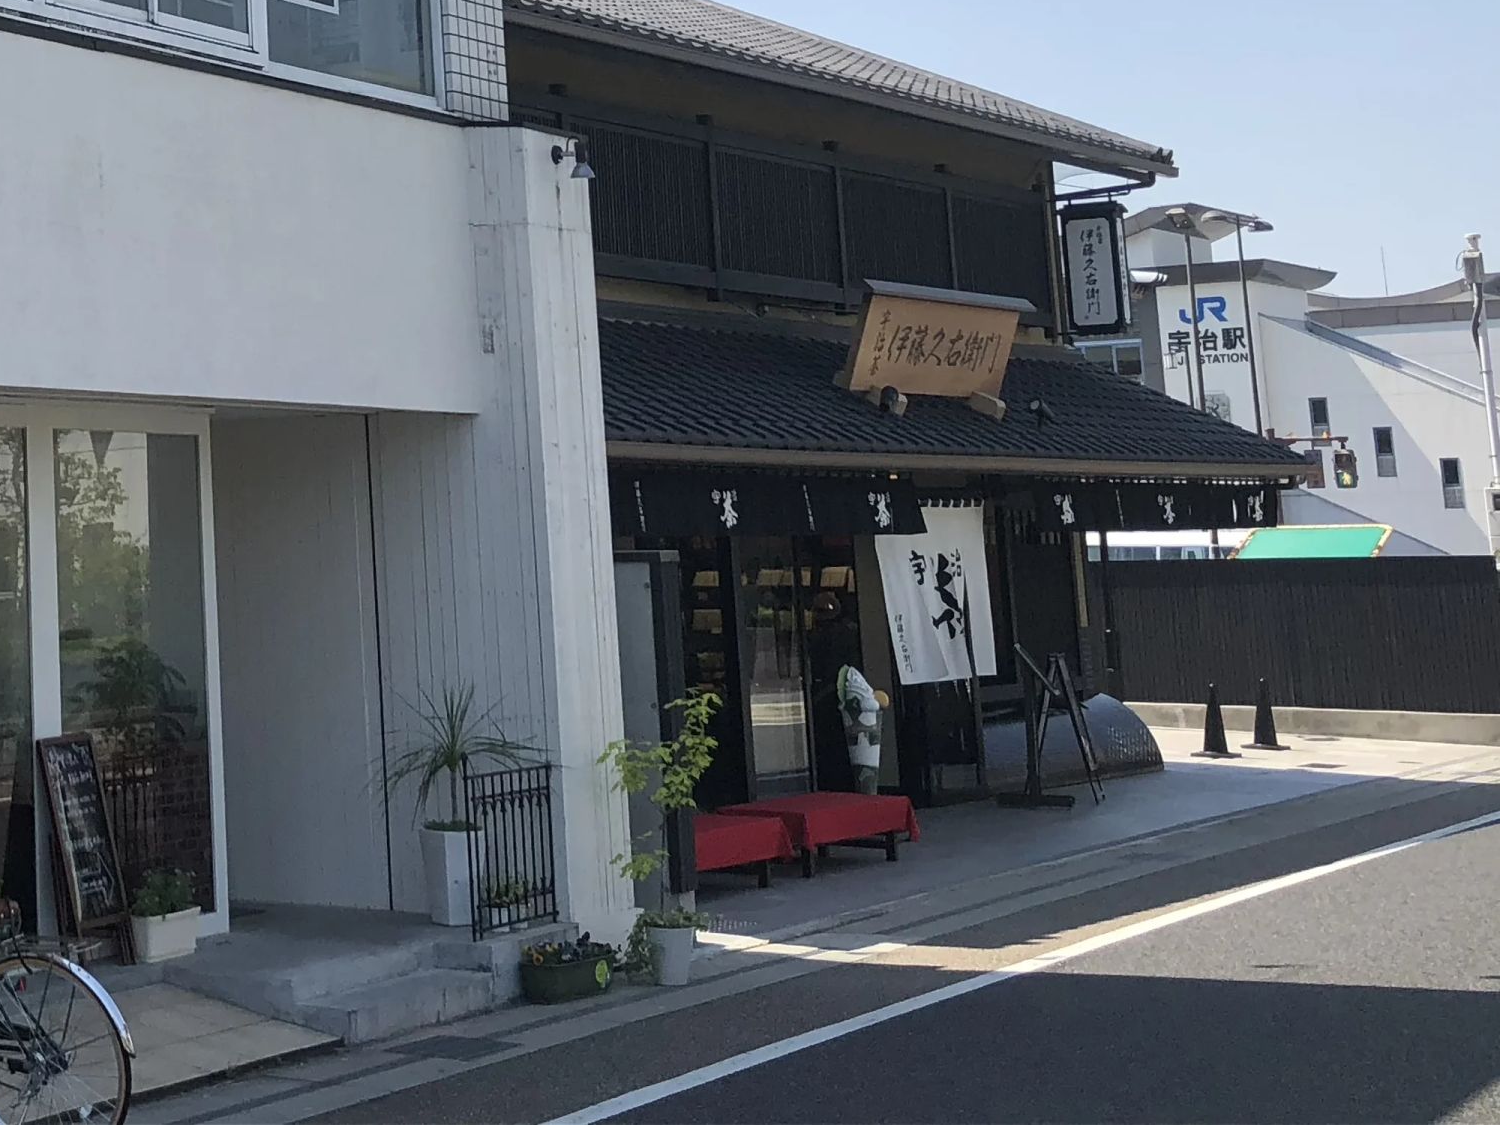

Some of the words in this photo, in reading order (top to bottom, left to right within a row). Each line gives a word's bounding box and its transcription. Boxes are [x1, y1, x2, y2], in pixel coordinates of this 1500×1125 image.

[1080, 228, 1101, 316] 伊藤久右衛門
[1179, 296, 1228, 324] JR
[888, 325, 1001, 373] 伊藤久右衛門
[1200, 352, 1248, 365] STATION
